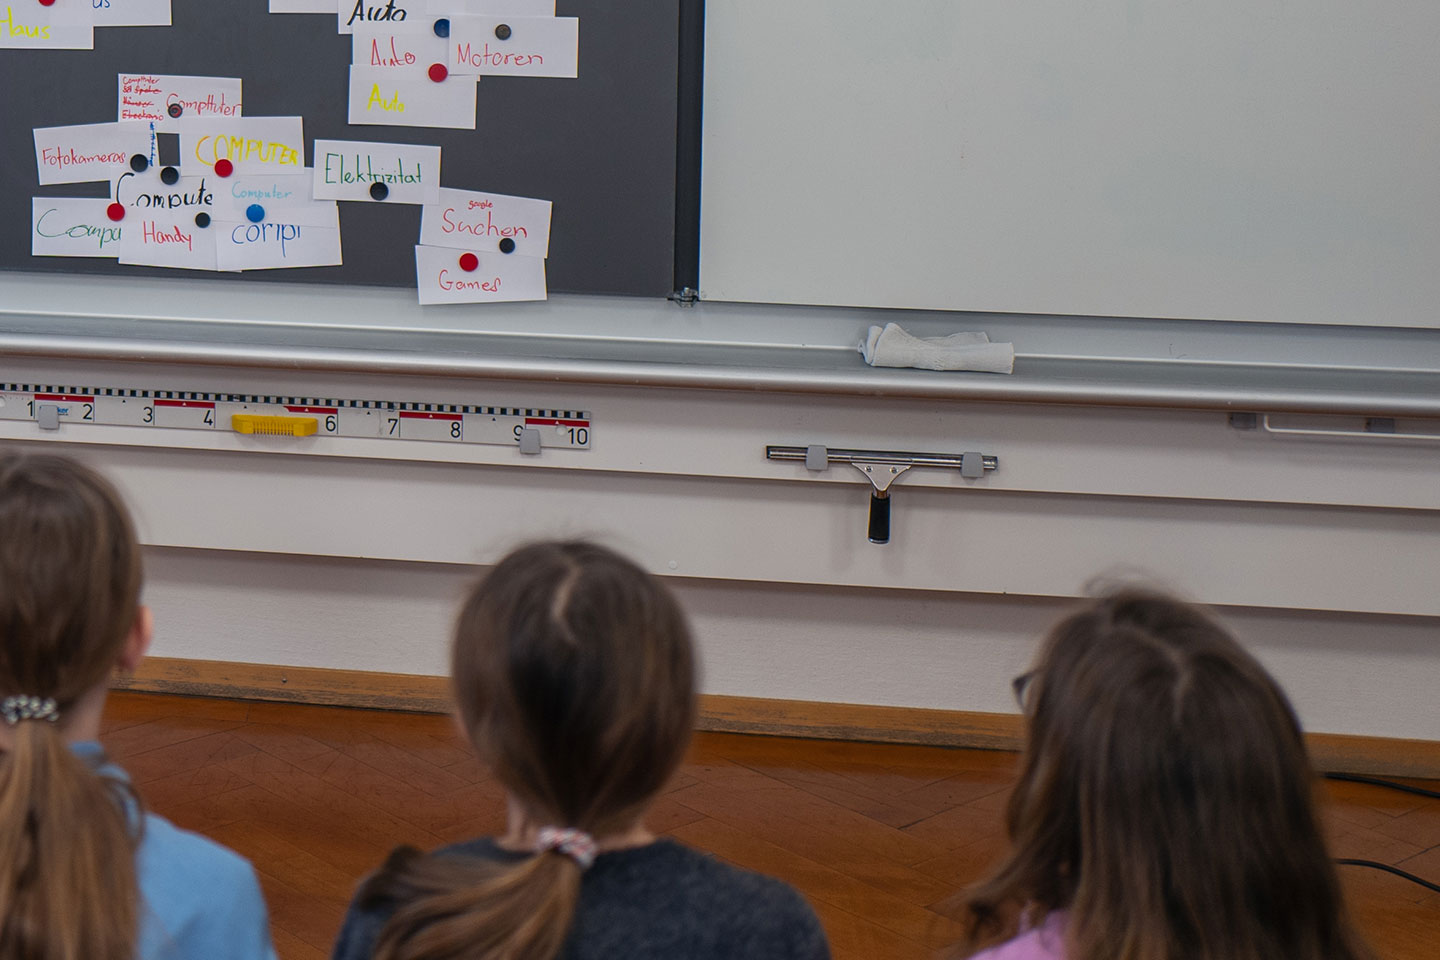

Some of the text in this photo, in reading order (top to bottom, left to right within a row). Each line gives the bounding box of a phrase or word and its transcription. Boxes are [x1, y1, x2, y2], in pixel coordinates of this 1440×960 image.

[457, 43, 544, 67] Motoren
[367, 83, 405, 112] Auto
[42, 146, 126, 170] Fotokameras
[195, 134, 298, 166] COMPUTER
[117, 172, 213, 209] Compute
[232, 181, 292, 201] Computer
[468, 199, 494, 210] google
[143, 221, 192, 251] Handy
[439, 269, 502, 292] Games
[27, 401, 33, 417] 1
[83, 403, 93, 420] 2
[143, 407, 153, 423] 3
[203, 409, 213, 426] 4
[325, 415, 336, 432] 6
[387, 418, 398, 435] 7
[451, 421, 461, 438] 8
[513, 424, 523, 441] 9
[568, 428, 588, 445] 10
